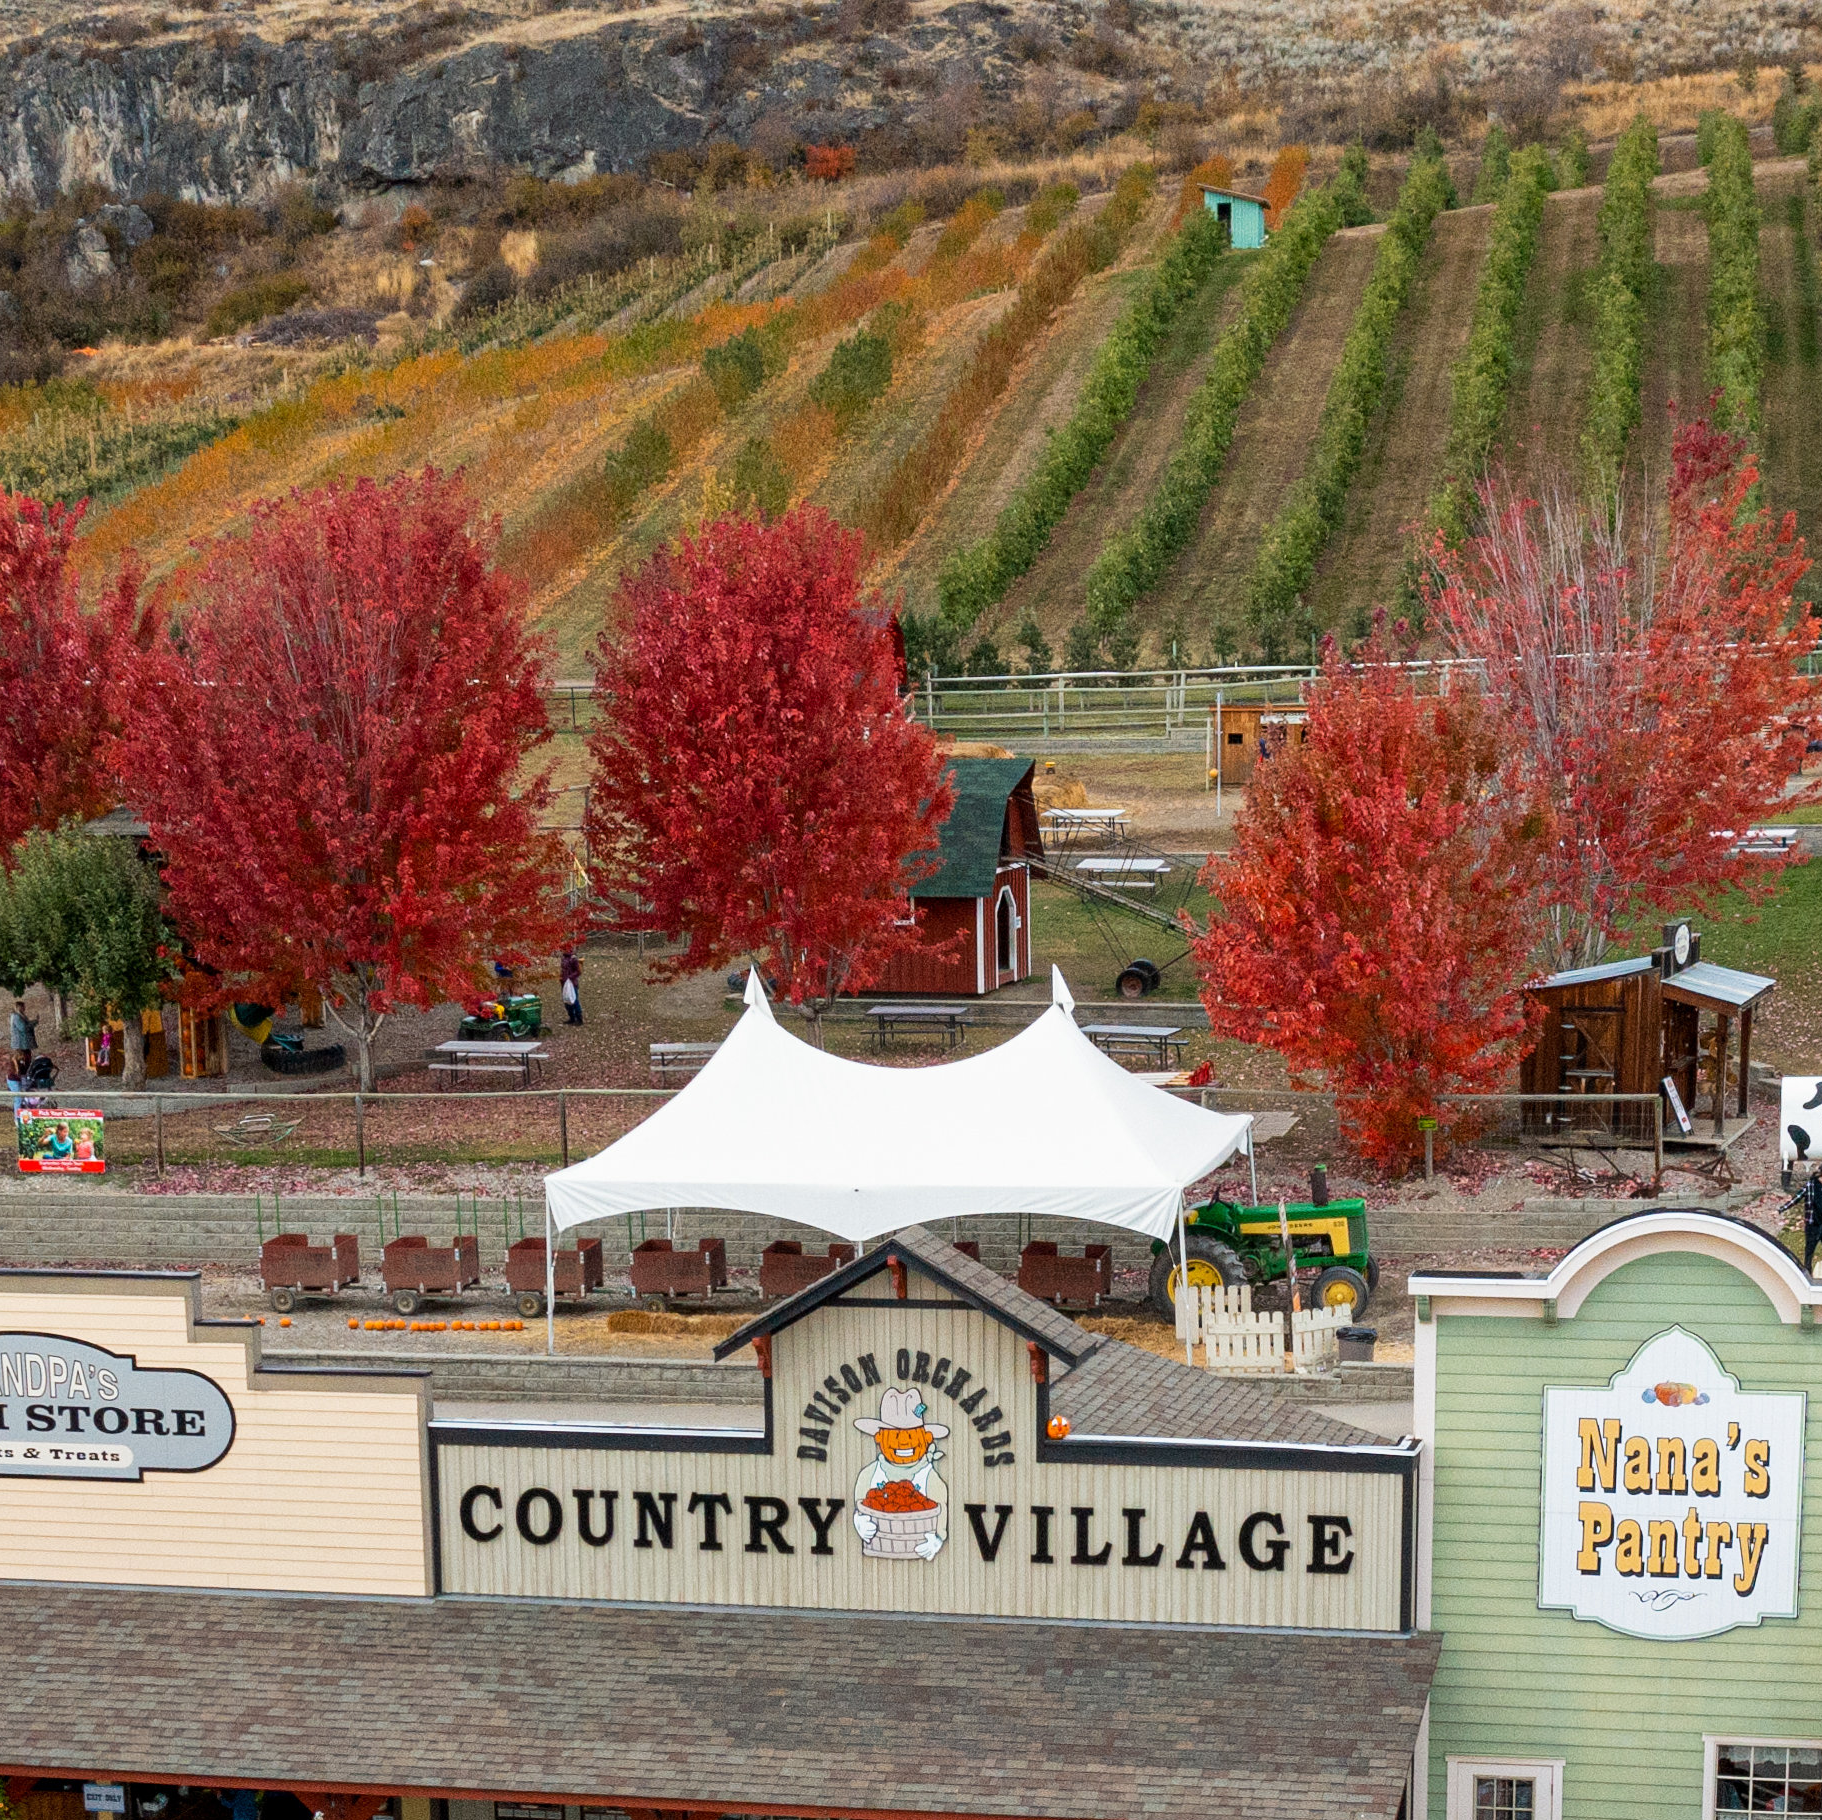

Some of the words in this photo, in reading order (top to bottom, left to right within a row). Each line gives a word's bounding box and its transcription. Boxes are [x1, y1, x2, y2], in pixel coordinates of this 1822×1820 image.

[26, 1404, 206, 1437] STORE
[797, 1353, 882, 1463] DAVISON
[896, 1348, 1016, 1467] ORCHARDS
[23, 1446, 40, 1459] &
[49, 1448, 121, 1463] Treats
[1576, 1417, 1771, 1499] Nana's
[459, 1484, 846, 1557] COUNTRY
[964, 1503, 1357, 1576] VILLAGE
[1576, 1500, 1769, 1597] Pantry
